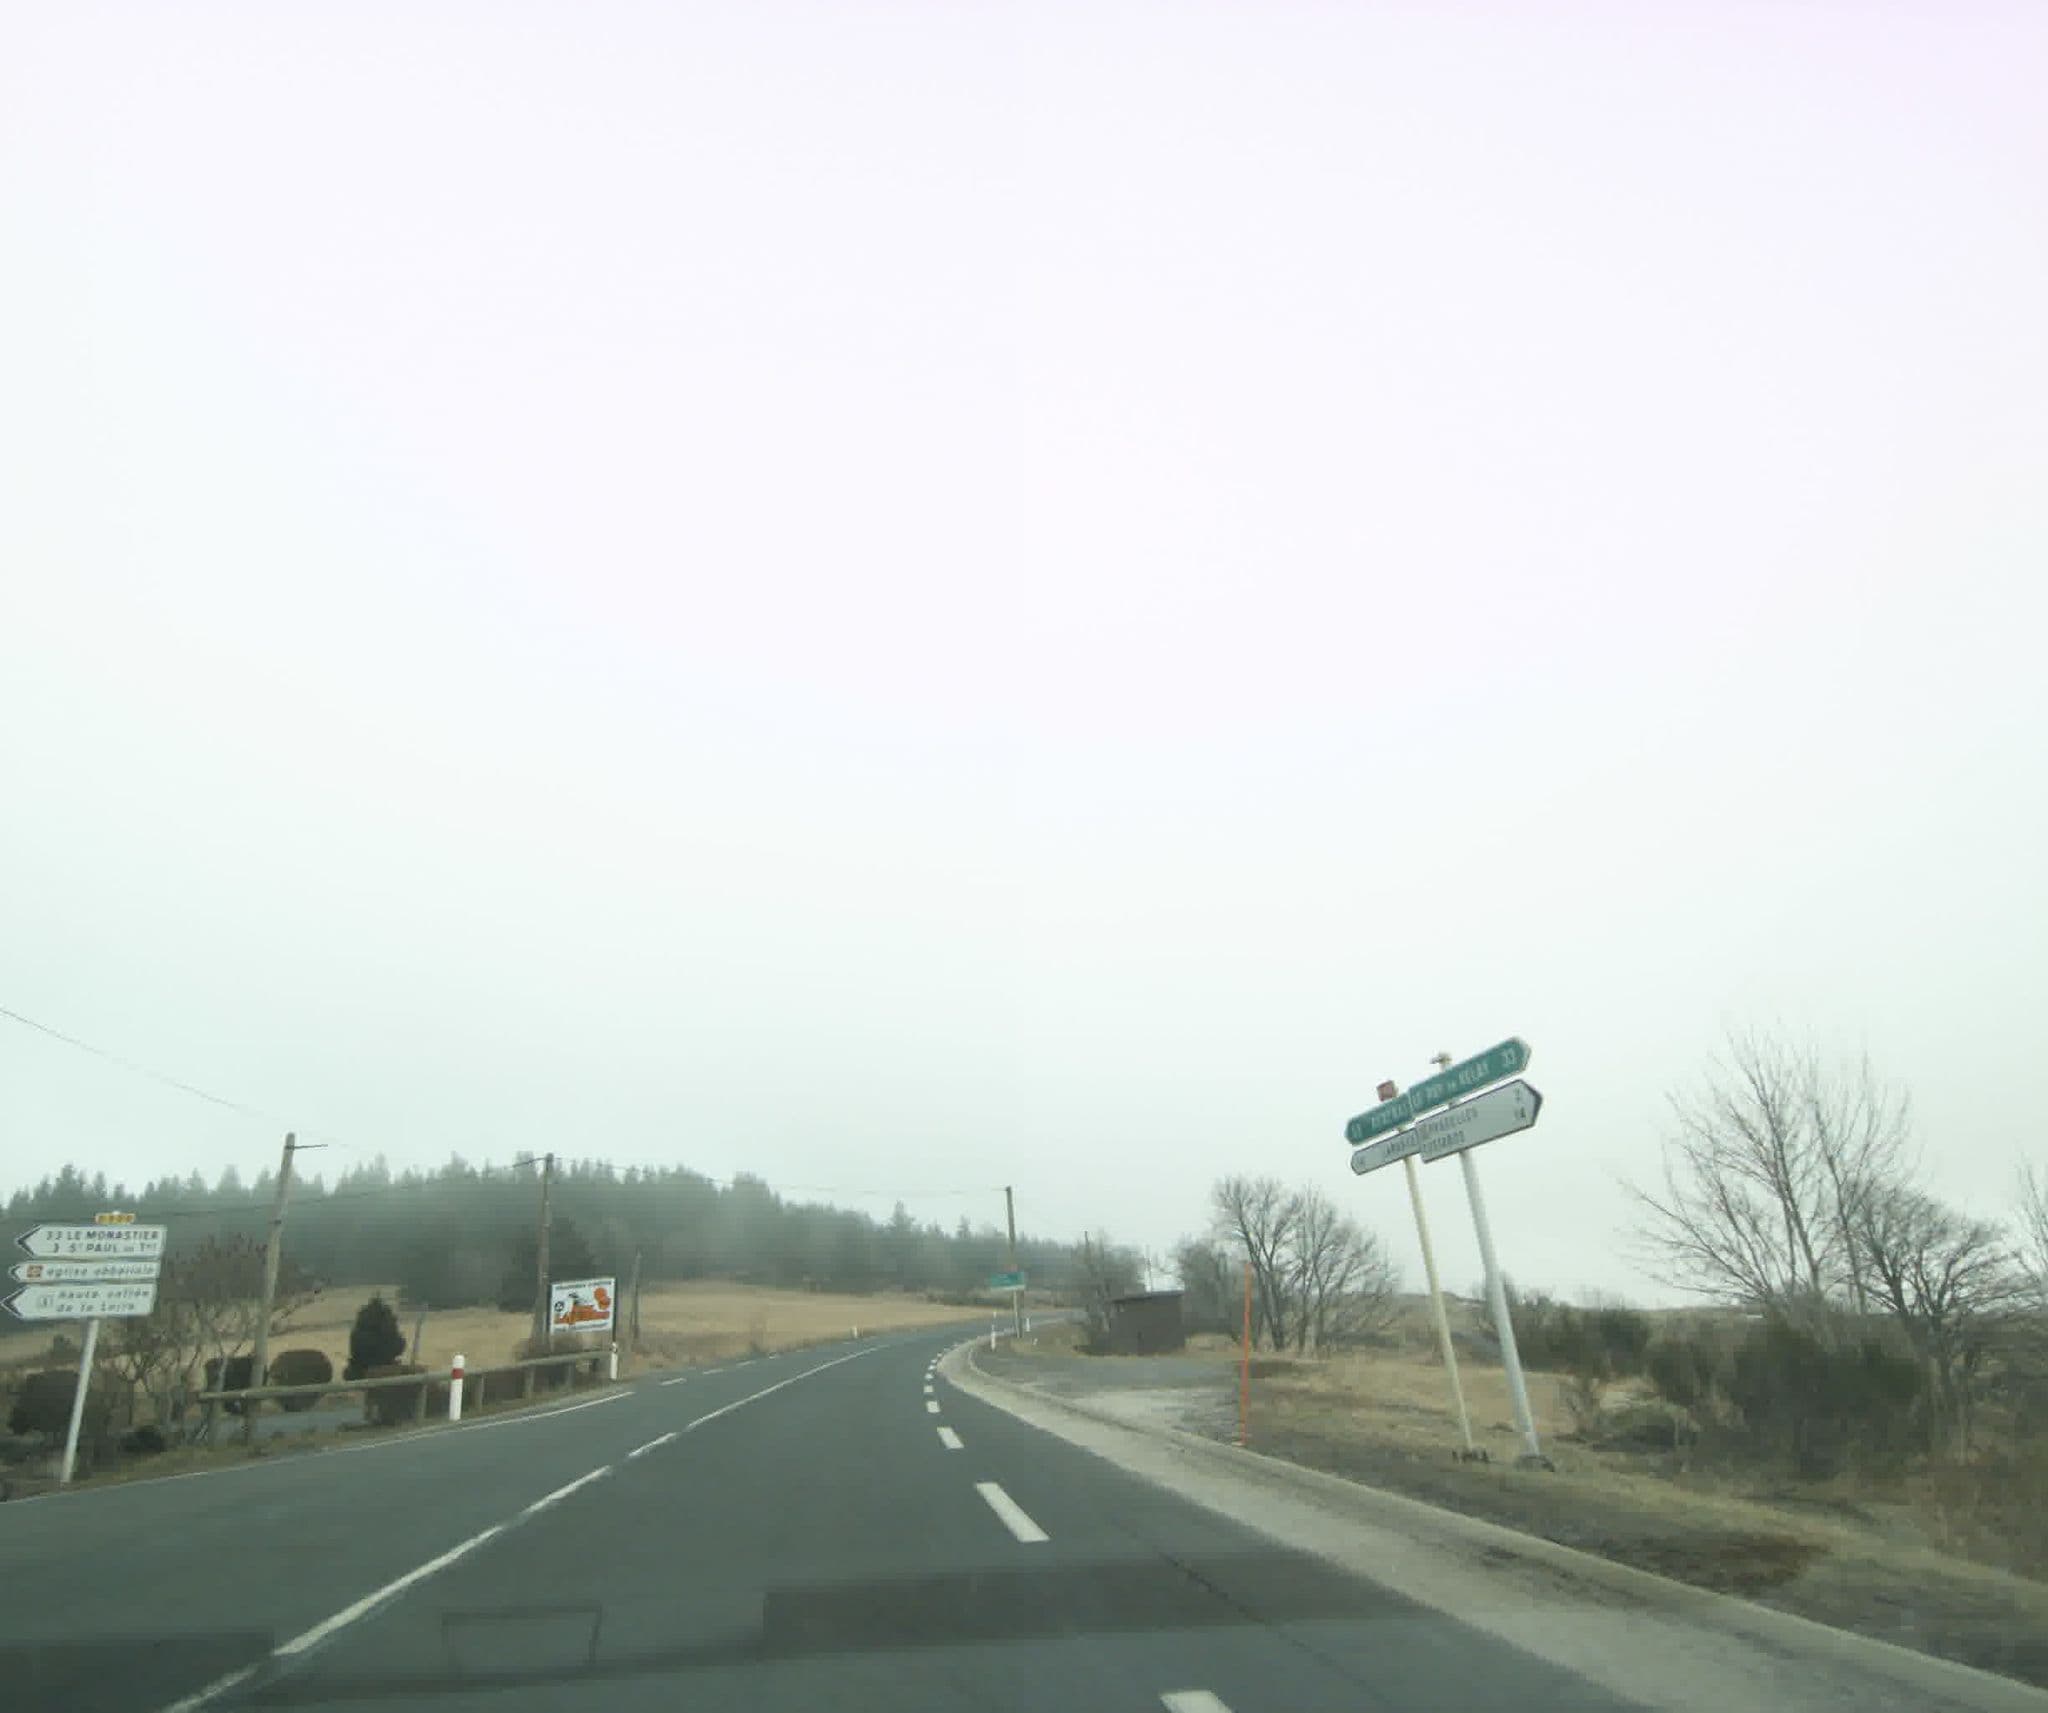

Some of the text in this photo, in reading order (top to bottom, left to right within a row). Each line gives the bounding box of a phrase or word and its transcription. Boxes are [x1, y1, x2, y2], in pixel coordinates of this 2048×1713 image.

[67, 1230, 81, 1241] LE
[86, 1230, 159, 1241] MONASTIER
[86, 1243, 118, 1253] PAUL
